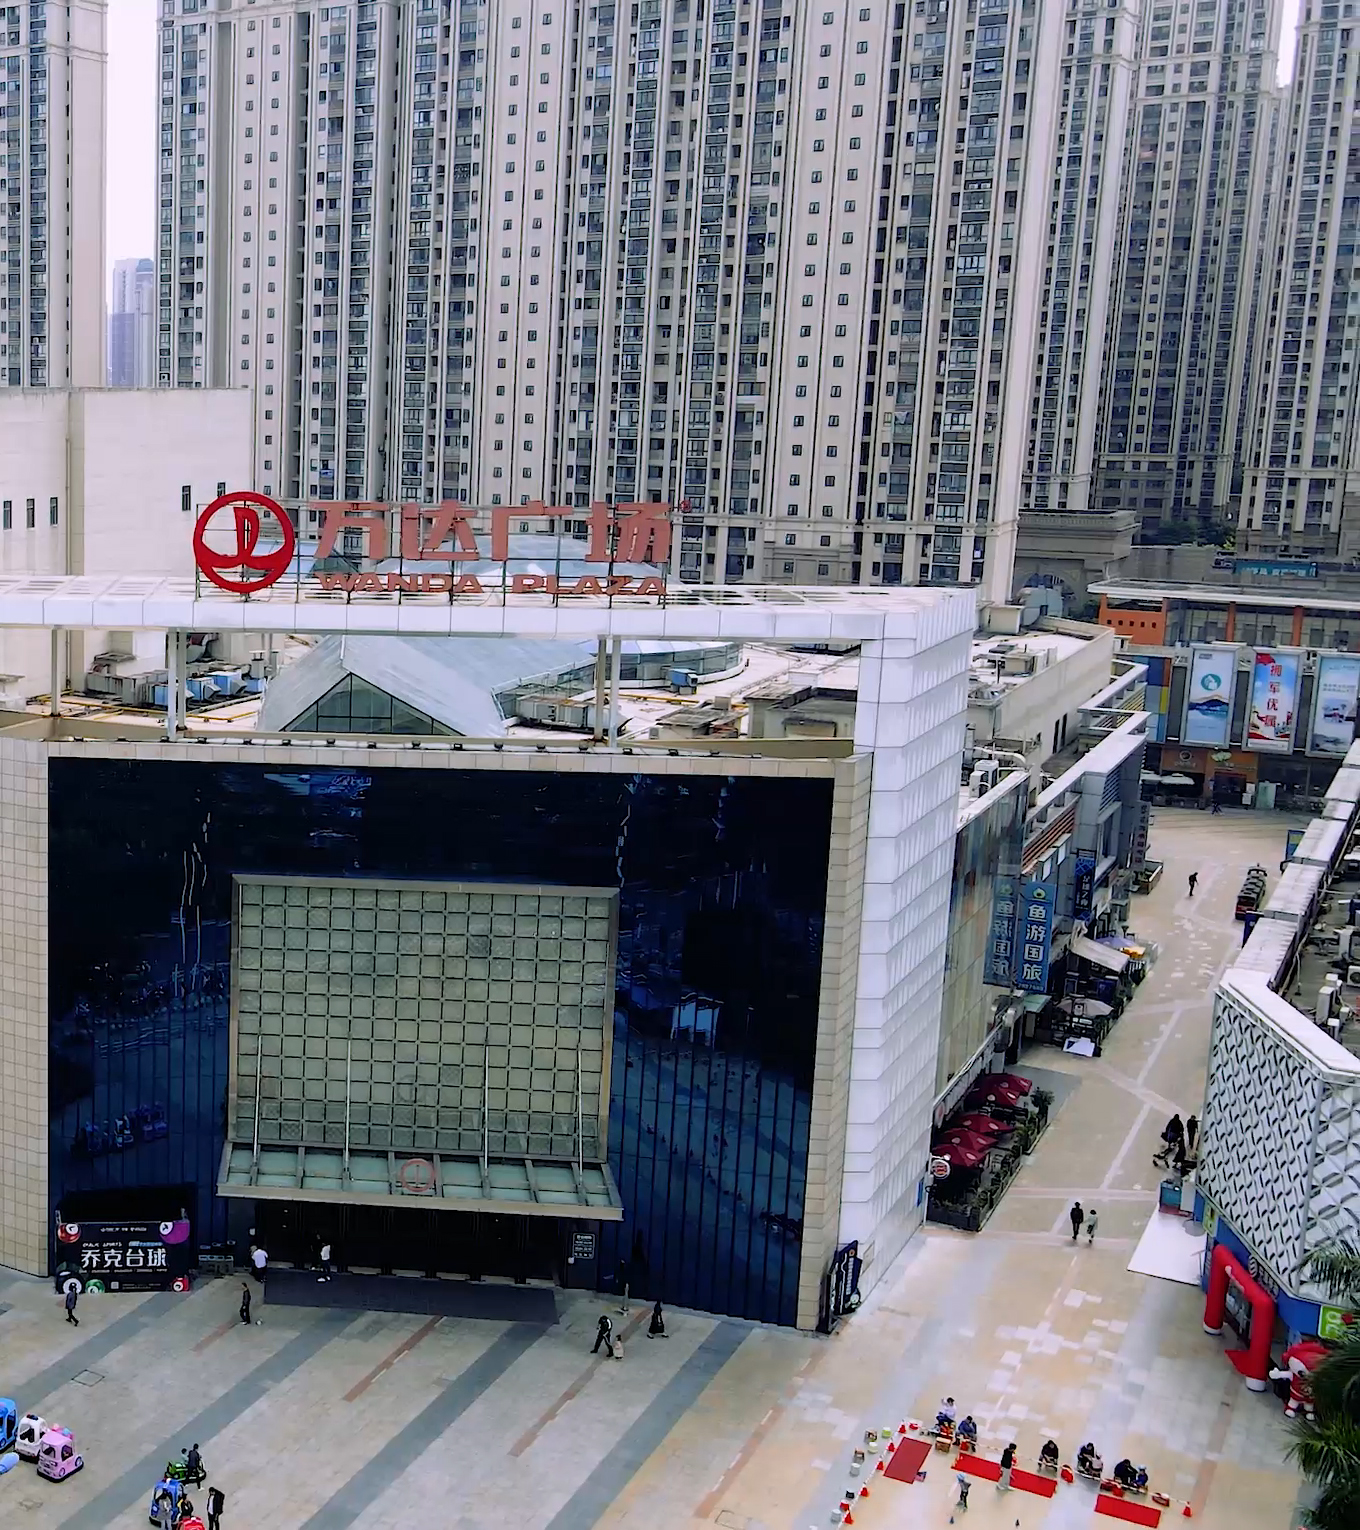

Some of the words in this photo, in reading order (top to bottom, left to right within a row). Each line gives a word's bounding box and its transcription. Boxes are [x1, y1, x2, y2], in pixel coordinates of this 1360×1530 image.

[310, 500, 674, 563] 万达广场
[317, 572, 484, 595] WANDA
[510, 575, 668, 597] PLAZA
[1022, 904, 1047, 981] 鱼游国旅
[81, 1248, 167, 1268] 乔克台球
